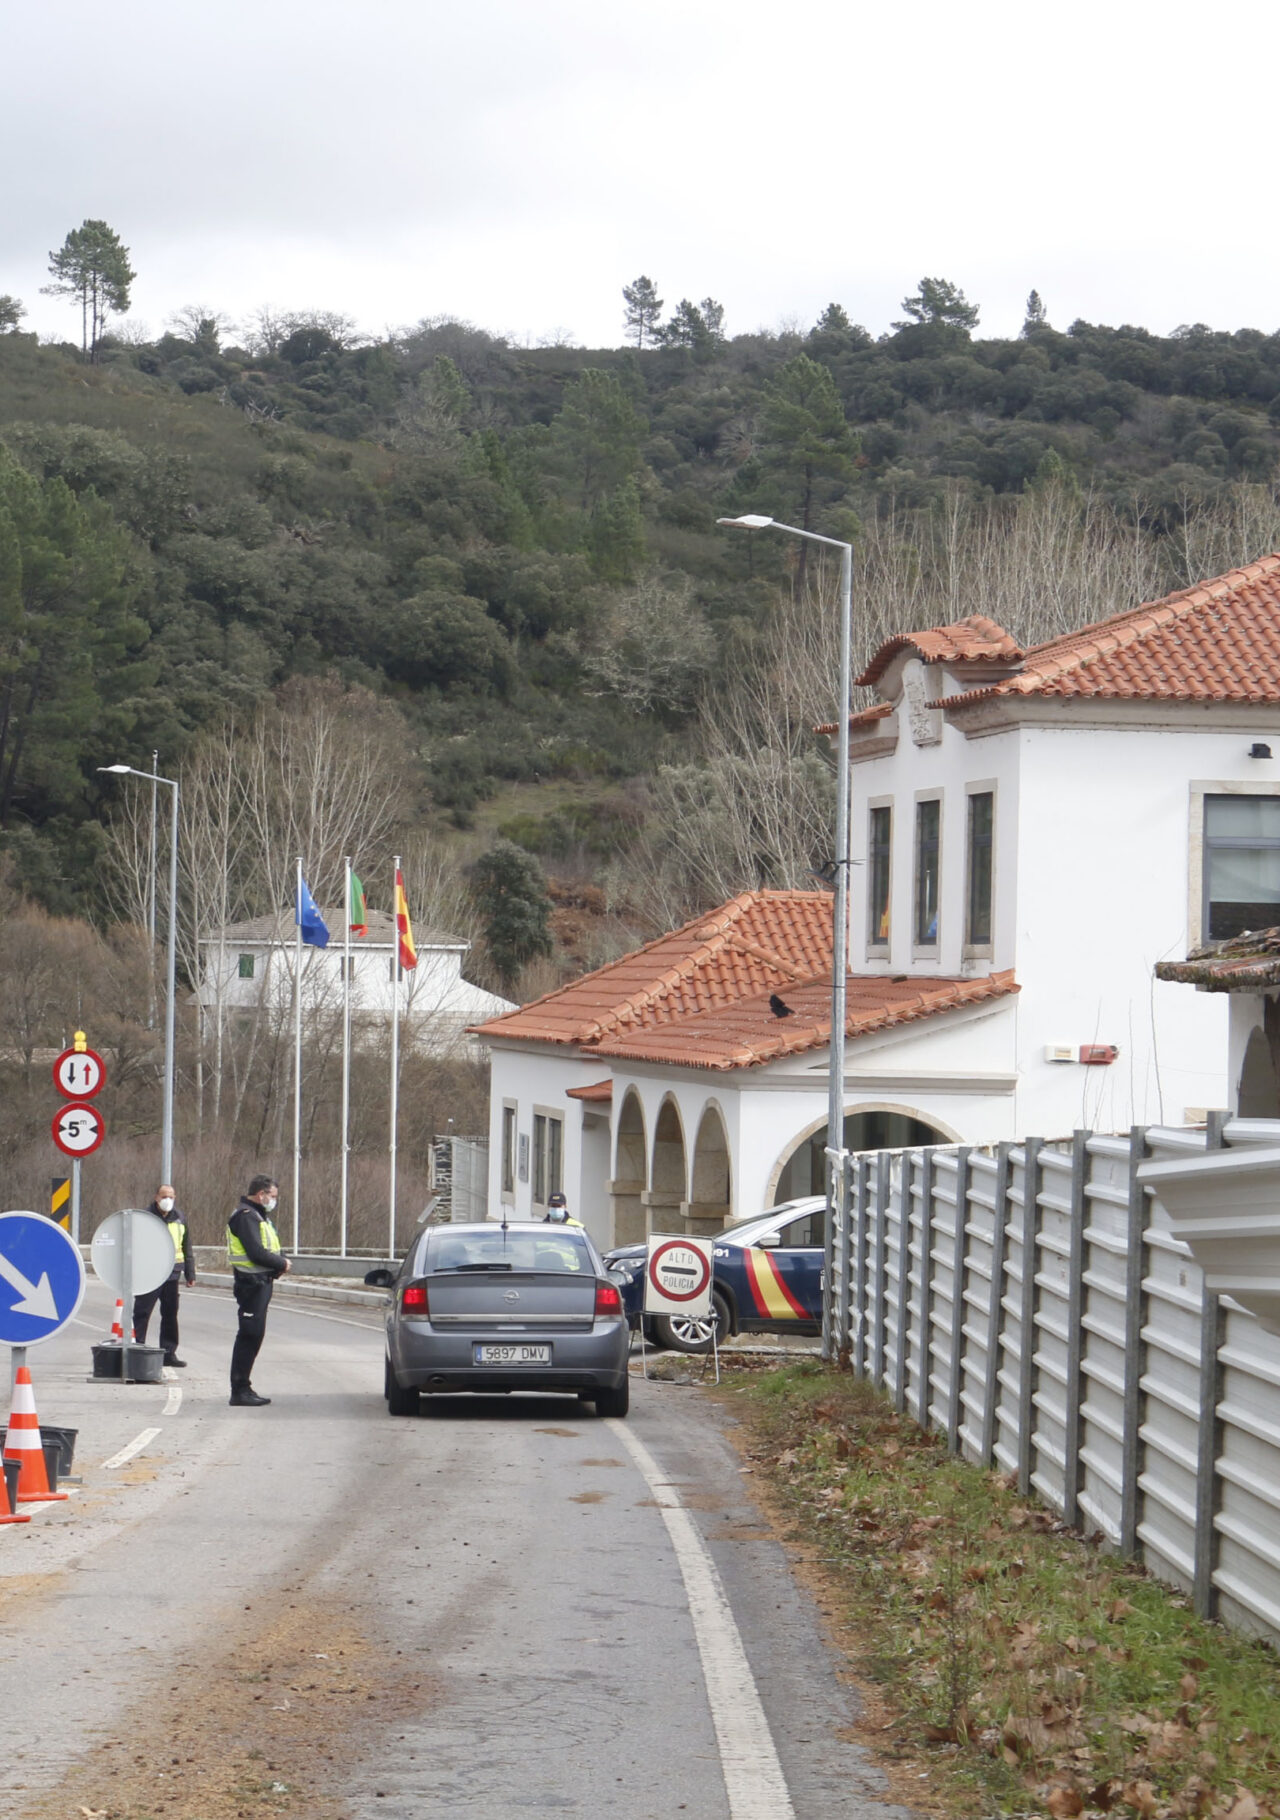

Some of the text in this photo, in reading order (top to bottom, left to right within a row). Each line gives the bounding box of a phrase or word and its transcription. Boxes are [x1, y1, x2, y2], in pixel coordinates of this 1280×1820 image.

[669, 1252, 693, 1264] ALTO
[663, 1276, 694, 1289] POLICIA
[485, 1347, 544, 1359] 5897 DMV
